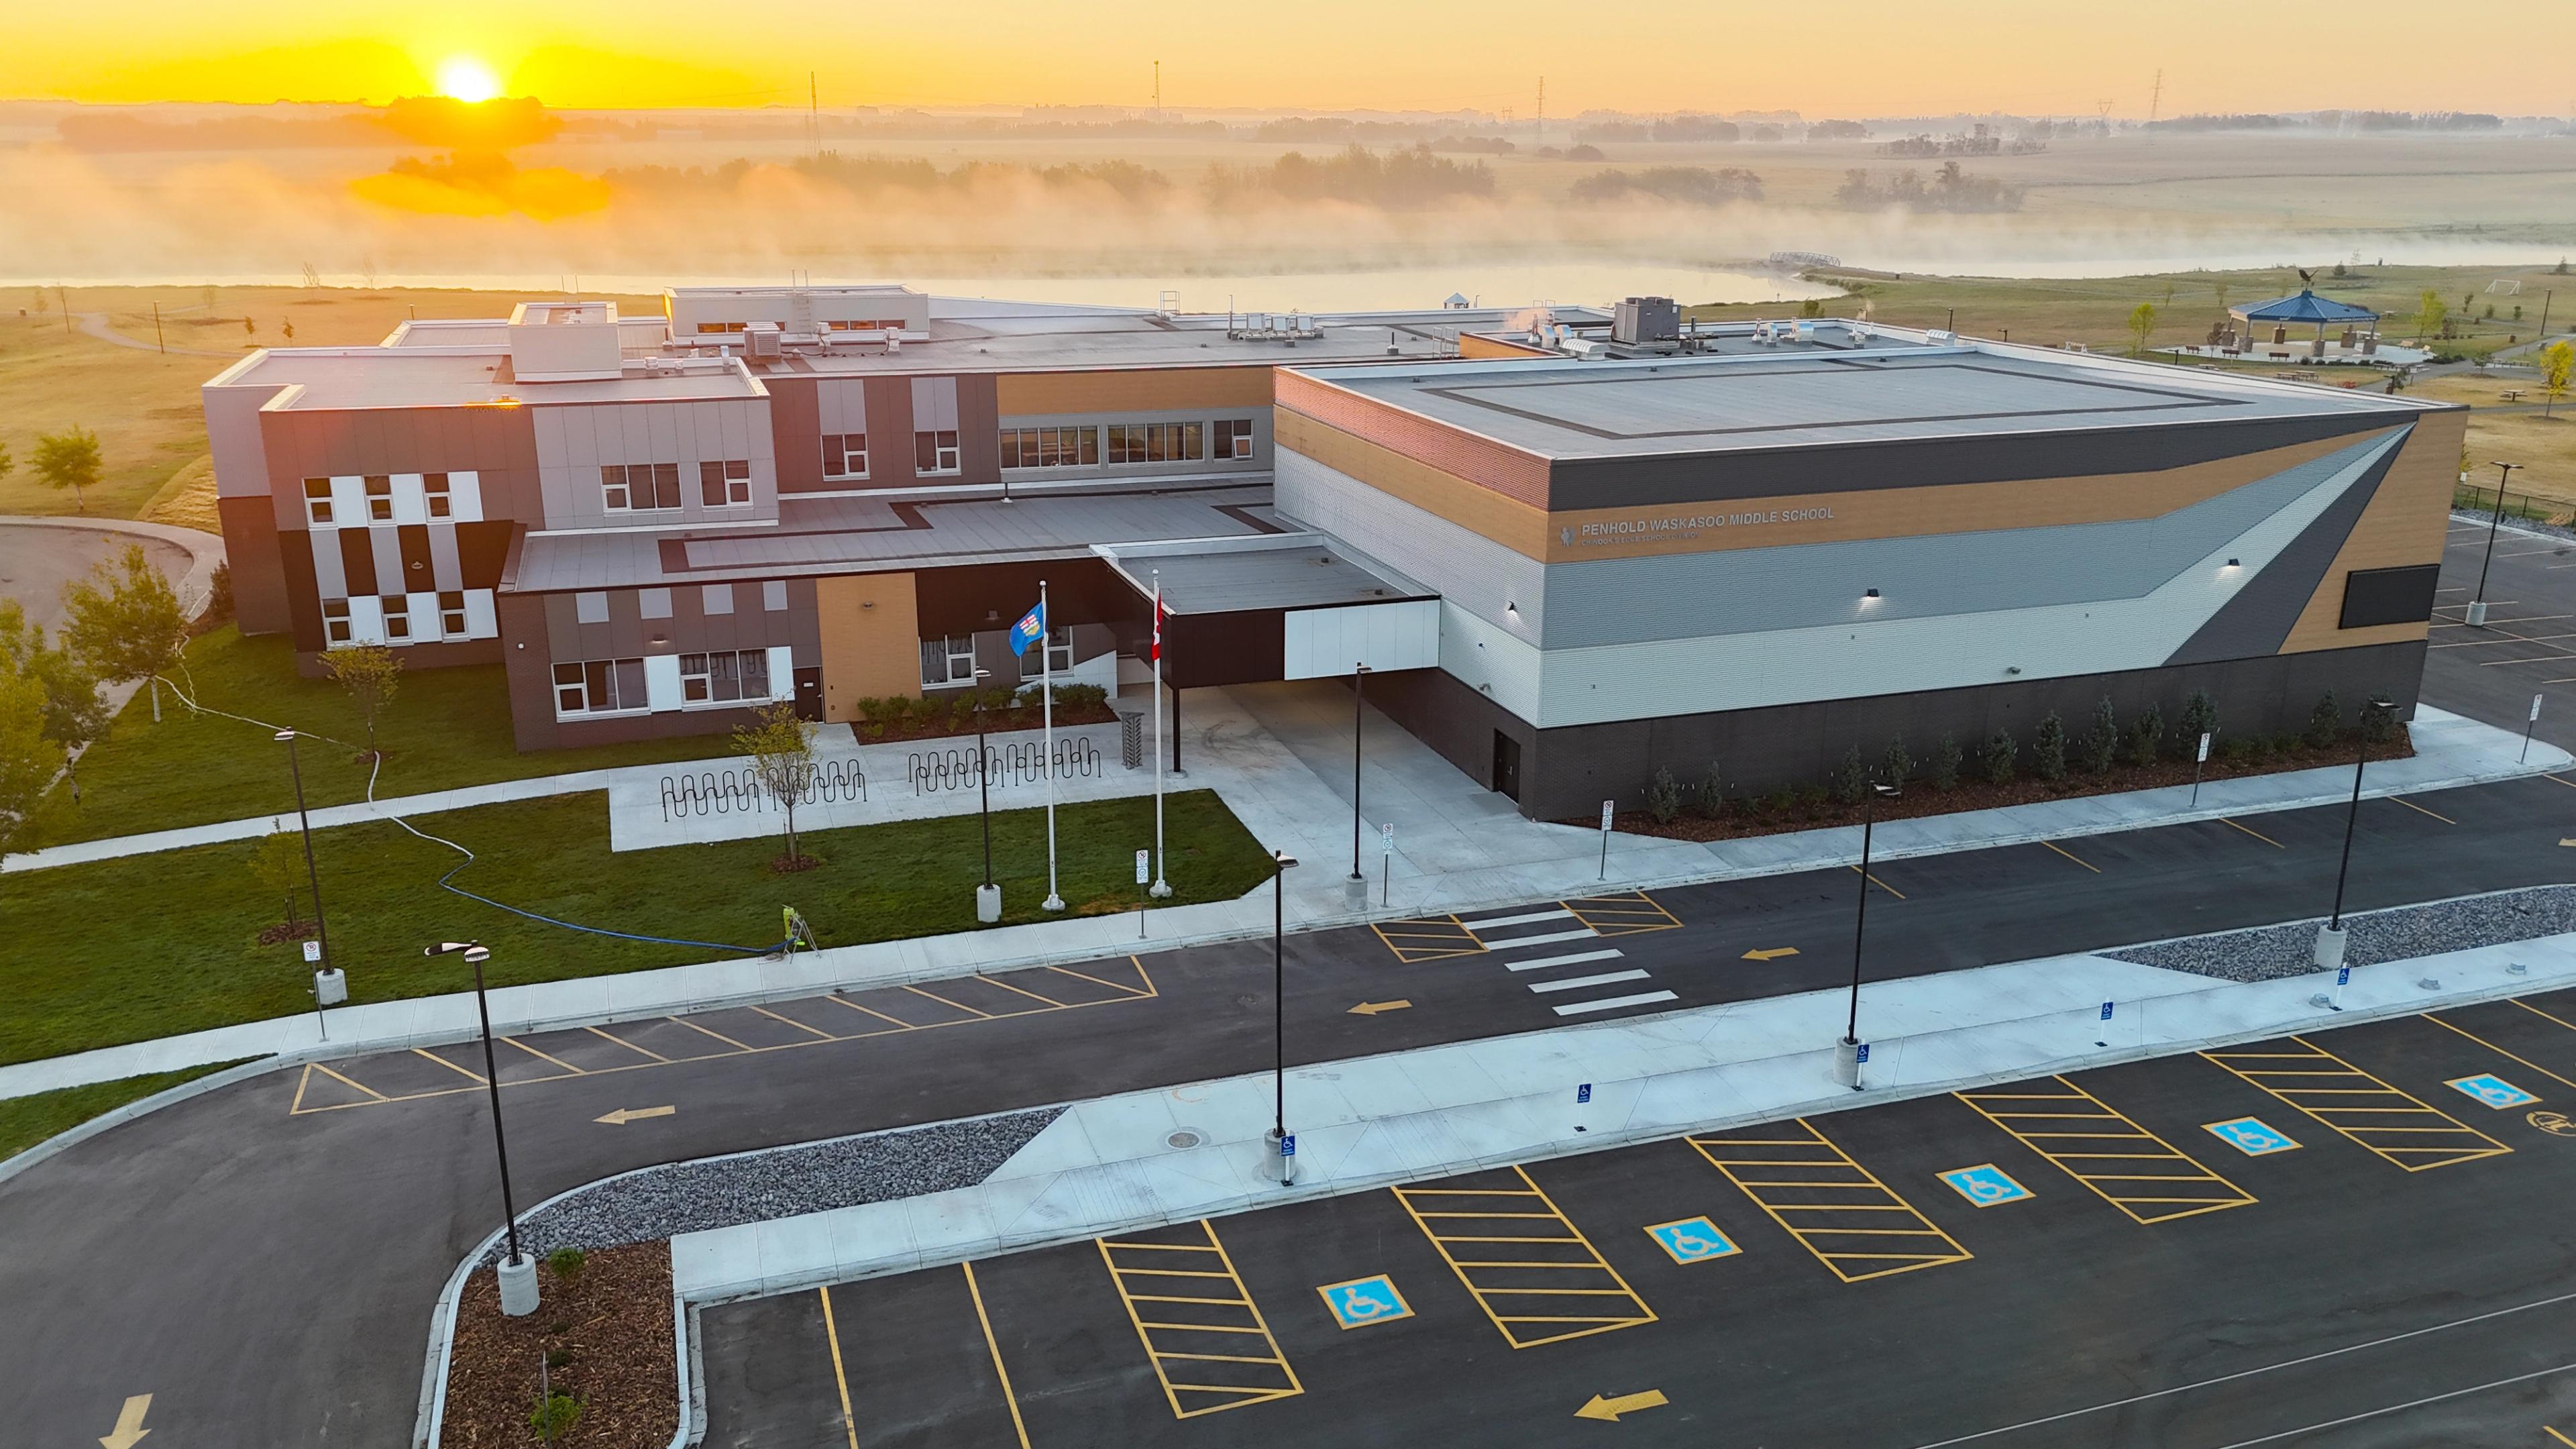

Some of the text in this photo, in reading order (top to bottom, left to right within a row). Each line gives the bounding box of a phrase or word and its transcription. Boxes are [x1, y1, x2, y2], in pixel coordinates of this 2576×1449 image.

[1582, 507, 1835, 536] PENHOLD WASKASOO MIDDLE SCHOOL
